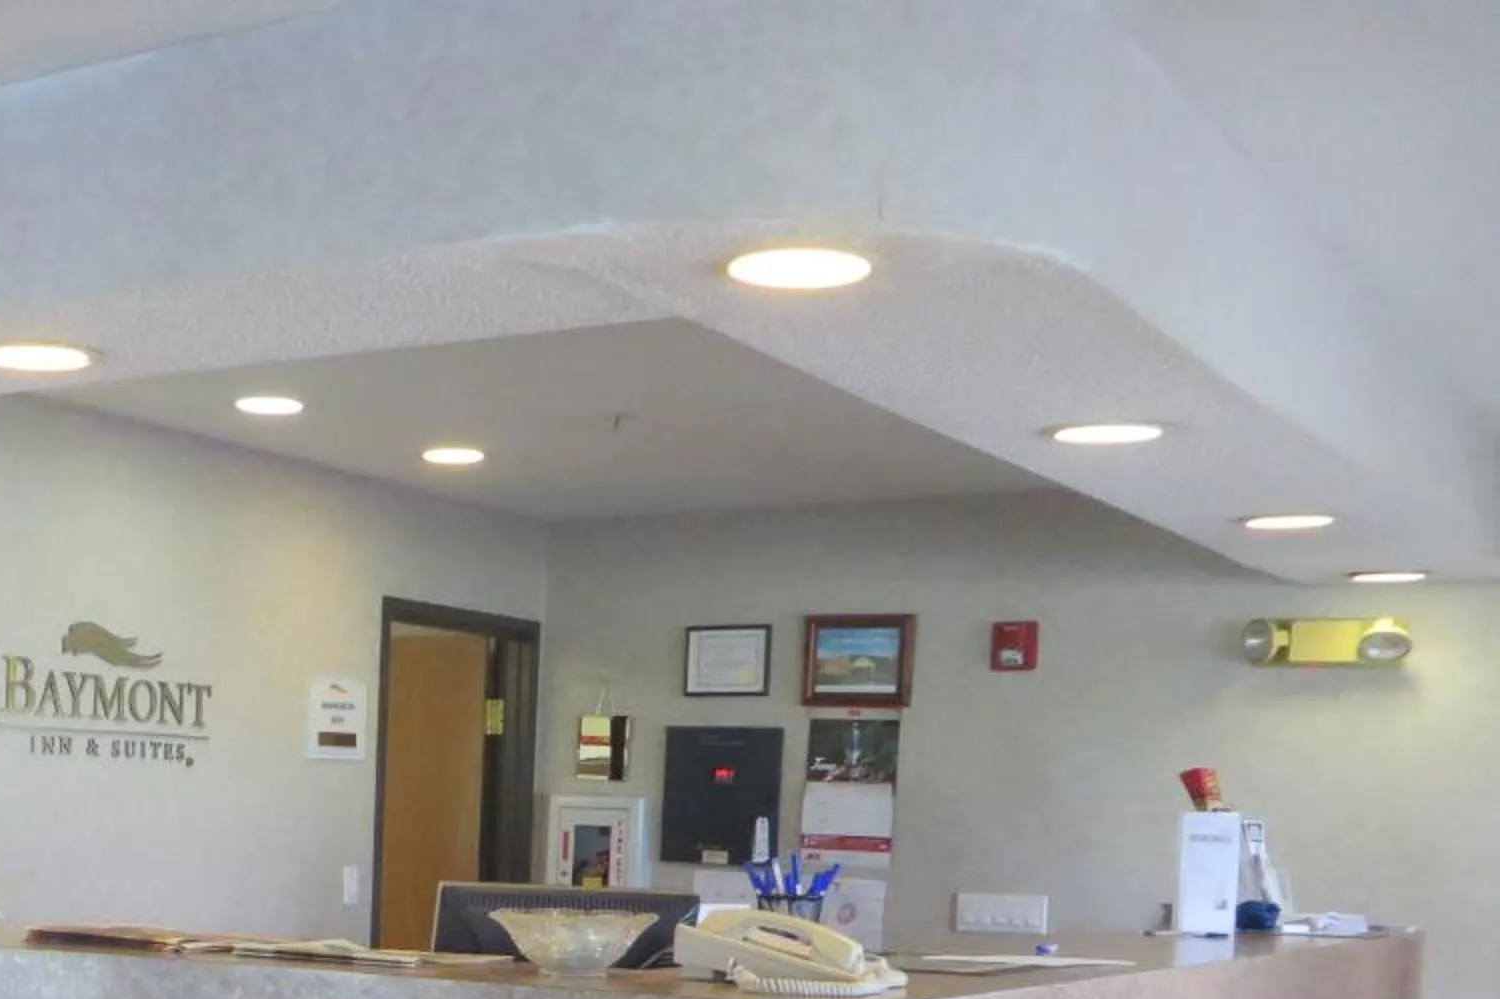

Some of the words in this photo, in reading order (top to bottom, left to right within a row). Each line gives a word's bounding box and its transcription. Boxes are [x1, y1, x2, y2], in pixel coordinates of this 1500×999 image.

[0, 655, 212, 728] BAYMONT
[30, 735, 72, 754] INN
[85, 737, 99, 756] &
